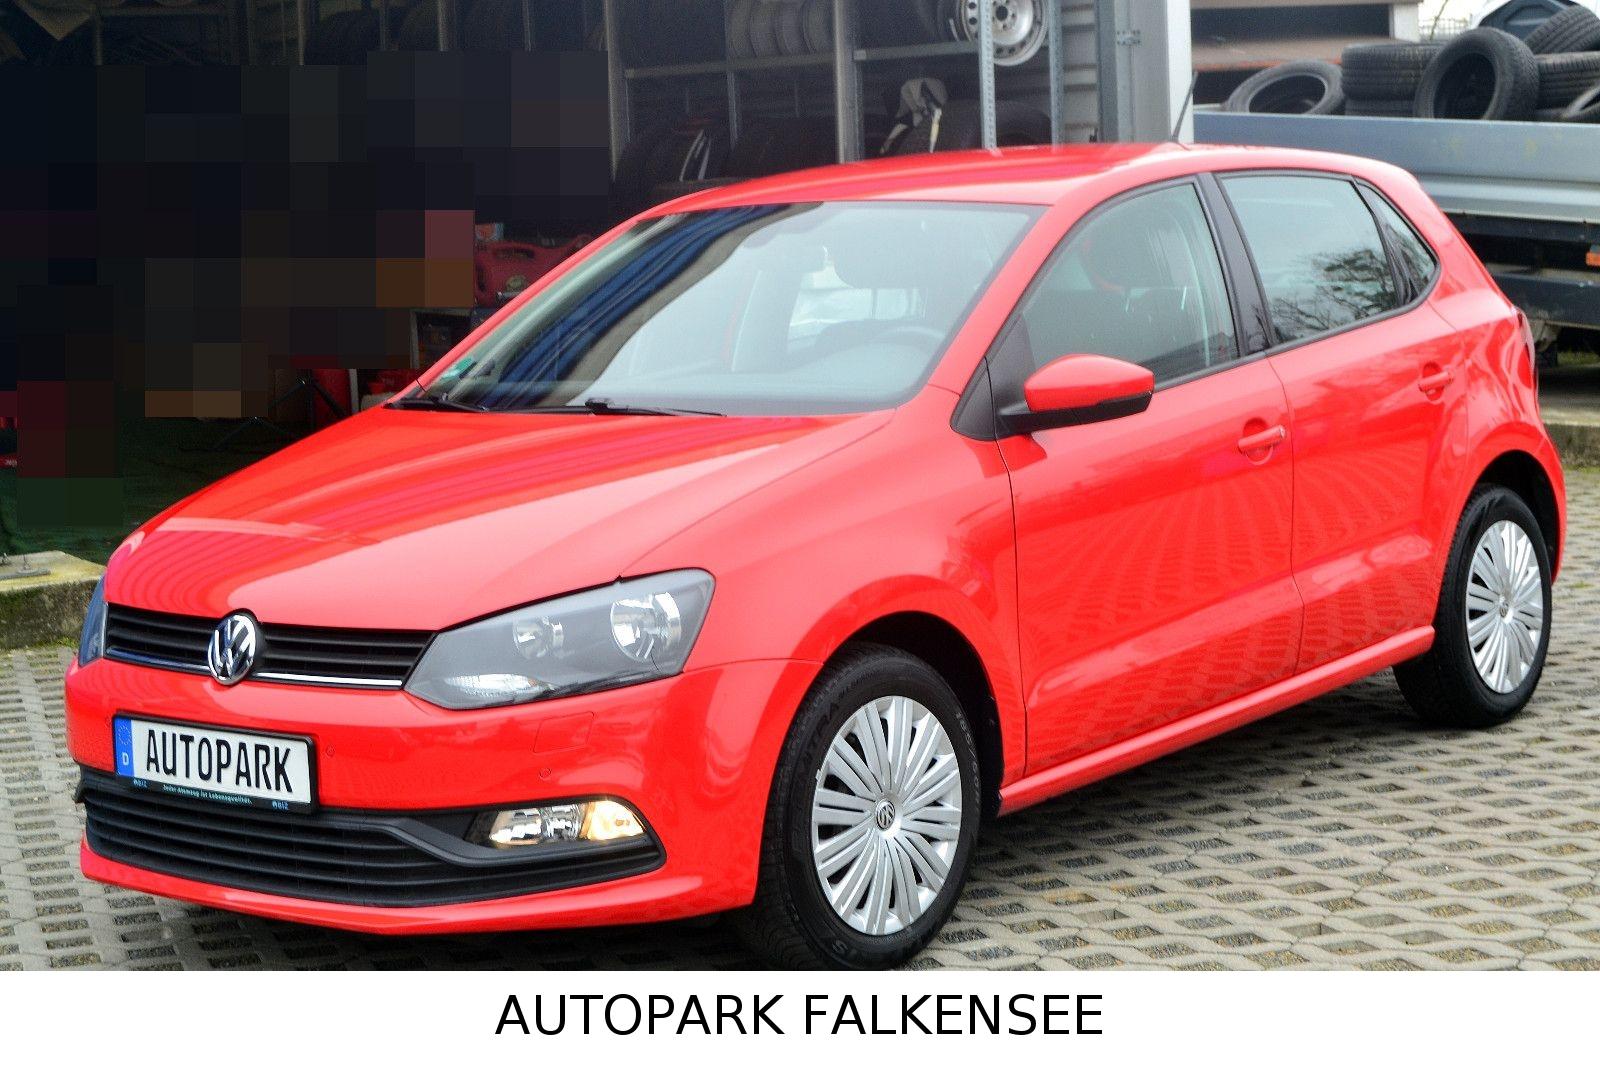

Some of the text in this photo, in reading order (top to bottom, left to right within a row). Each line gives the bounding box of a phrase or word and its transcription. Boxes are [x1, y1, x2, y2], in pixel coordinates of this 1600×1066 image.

[208, 614, 256, 685] VW
[121, 752, 130, 766] D
[146, 729, 293, 793] AUTOPARK
